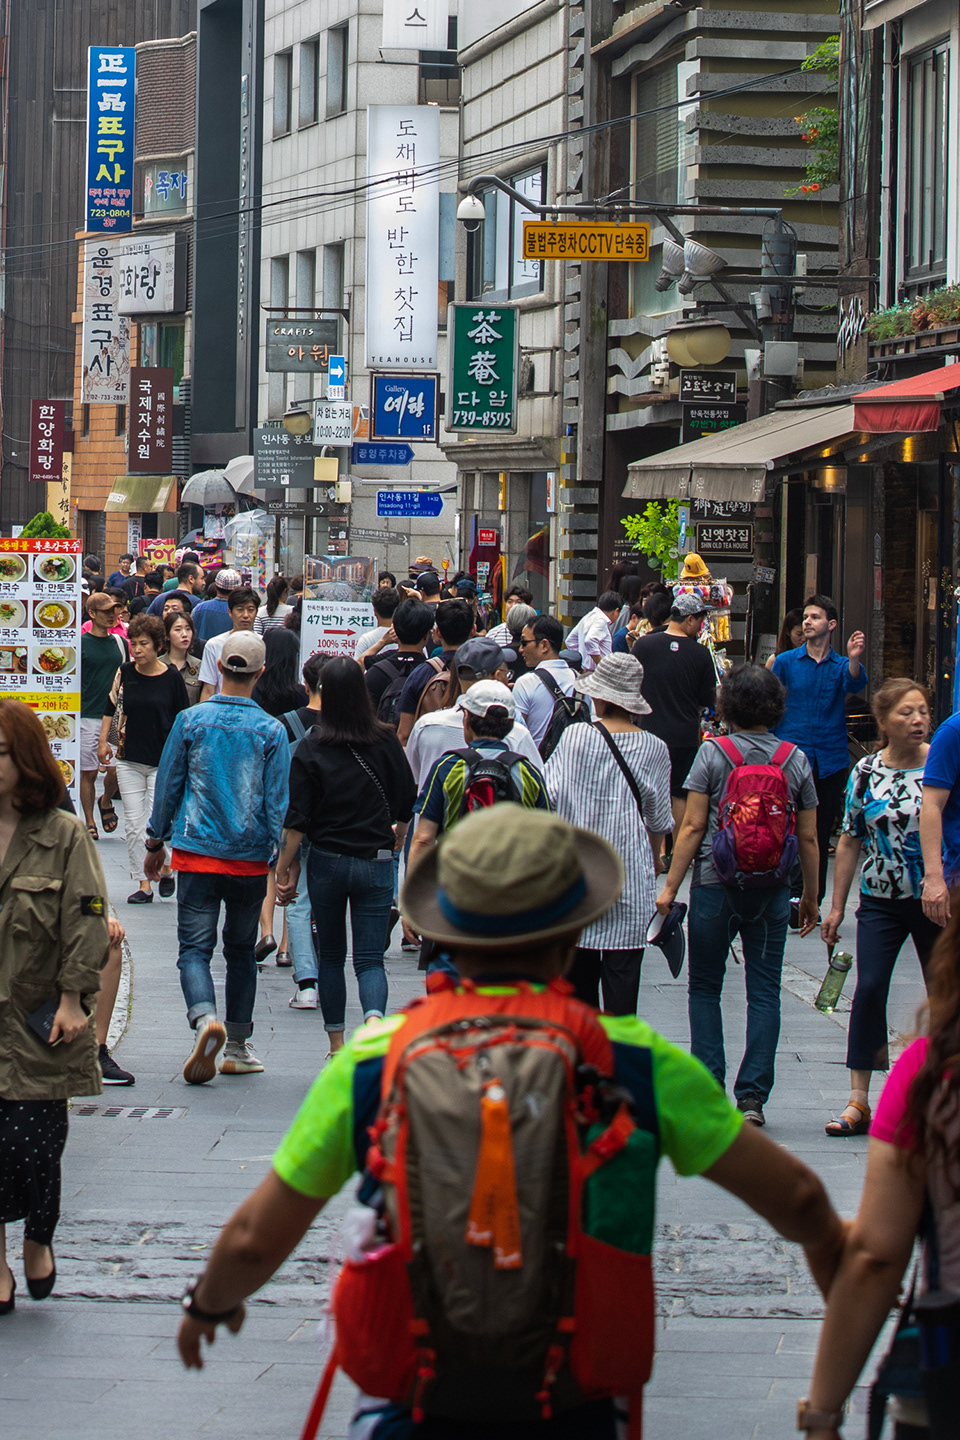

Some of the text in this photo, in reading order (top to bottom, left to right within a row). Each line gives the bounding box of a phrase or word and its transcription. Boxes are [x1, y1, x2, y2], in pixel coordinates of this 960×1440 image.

[156, 170, 188, 200] 족자
[90, 209, 130, 217] 723-0804
[103, 217, 116, 227] 3F
[387, 225, 418, 275] 반한
[89, 247, 115, 377] 운경표구사
[393, 285, 419, 343] 찻집
[274, 327, 314, 336] CRAFTS
[288, 344, 328, 367] 아원
[371, 356, 433, 364] TEAHOUSE
[115, 383, 127, 392] 2F
[384, 385, 407, 394] Gallery
[714, 382, 734, 394] 소리
[316, 407, 351, 420] 차 없는 거리
[453, 410, 511, 427] 739-8595
[137, 380, 153, 459] 국제자수원
[690, 420, 717, 429] 47번가
[422, 424, 431, 435] 1F
[37, 405, 56, 470] 한양화랑
[261, 434, 291, 445] 인사동
[358, 448, 408, 460] 공영주차장
[379, 493, 420, 503] 인사동11길
[378, 502, 420, 510] Insadong 11-gil
[700, 528, 750, 542] 신옛찻집
[33, 541, 80, 552] 북촌칼국수
[144, 547, 176, 562] TOY
[306, 614, 375, 627] 47번가 찻집
[317, 639, 339, 648] 100%
[10, 675, 28, 685] 모밀
[36, 675, 72, 685] 비빔국수
[41, 701, 57, 710] 지하
